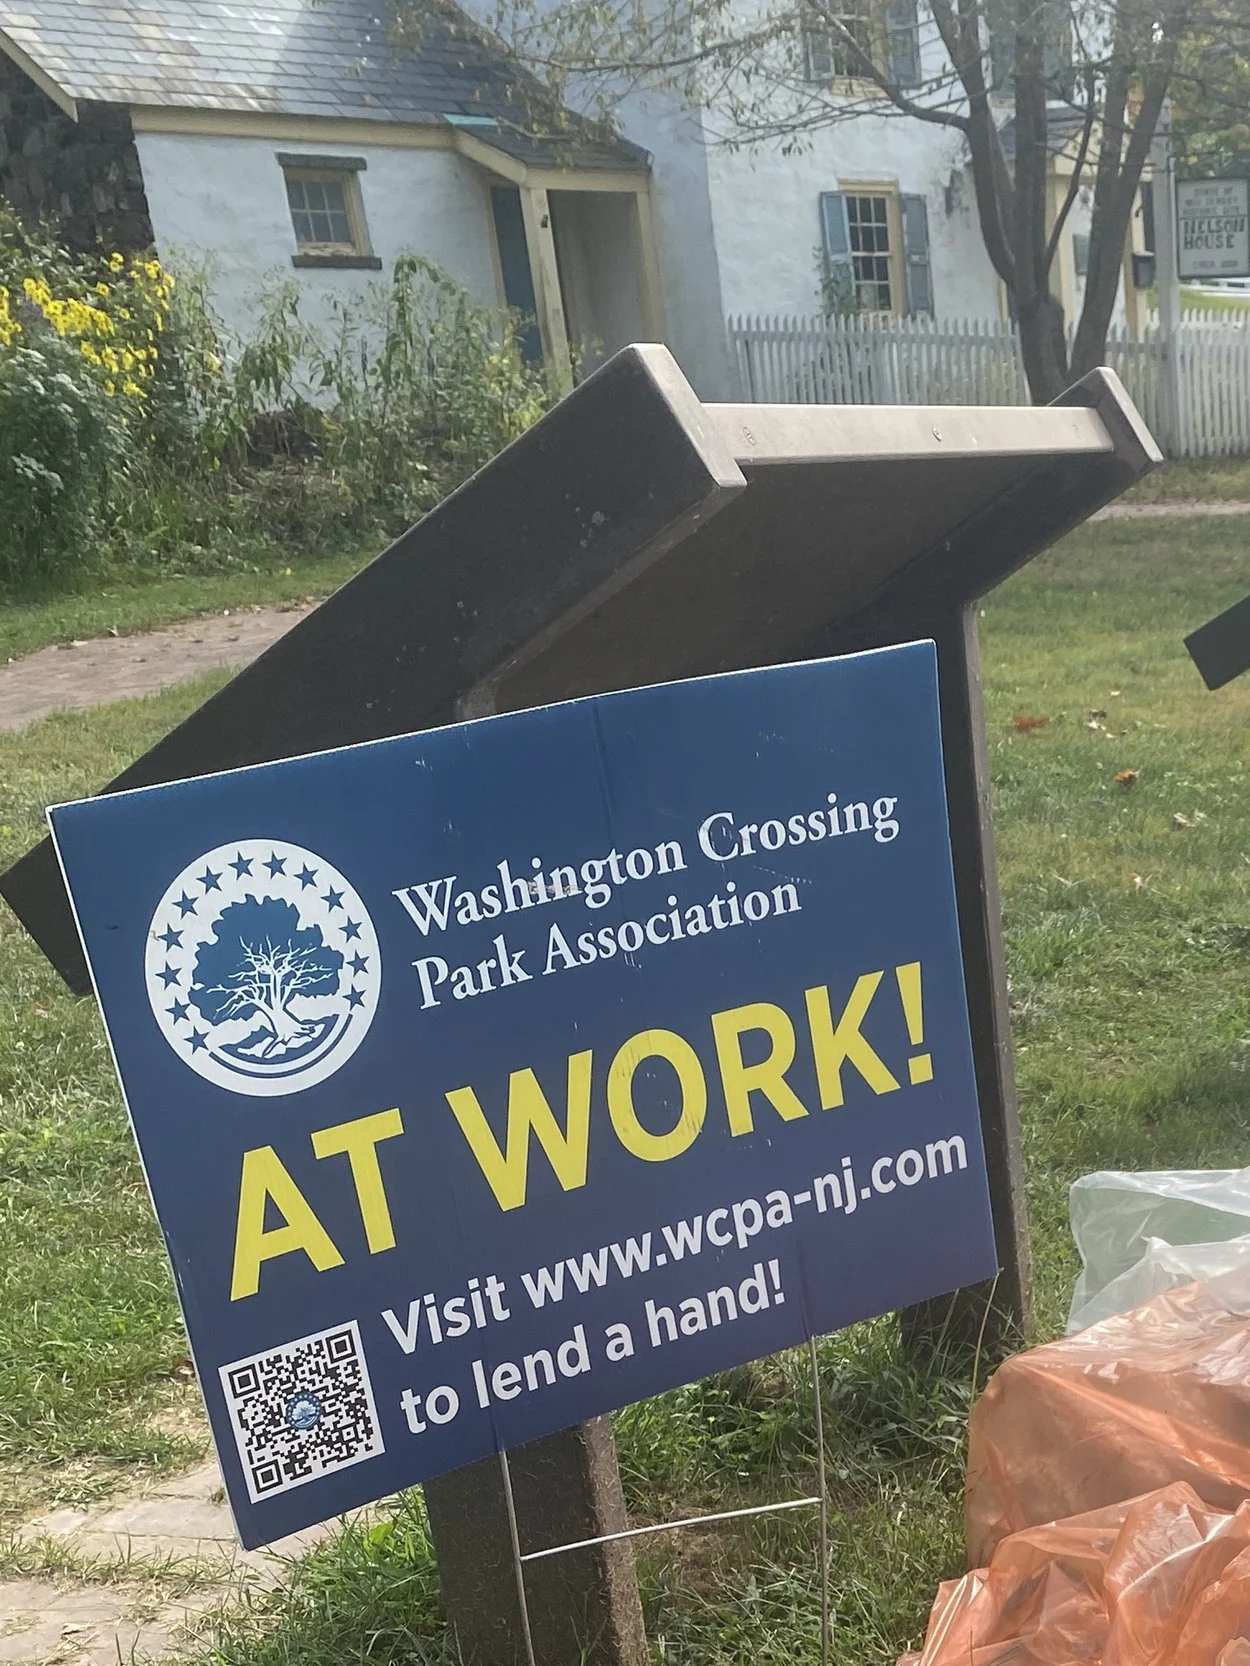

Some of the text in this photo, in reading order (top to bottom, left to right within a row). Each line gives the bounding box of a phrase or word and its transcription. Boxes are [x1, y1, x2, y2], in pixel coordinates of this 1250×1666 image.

[1183, 234, 1235, 250] HOUSE
[1184, 219, 1244, 234] NELSON
[391, 792, 900, 937] Washington Crossing
[411, 881, 803, 1010] Park Association
[231, 962, 935, 1300] AT WORK!
[380, 1134, 968, 1355] Visit www.wcpa-nj.com
[399, 1258, 786, 1434] to lend a hand!
